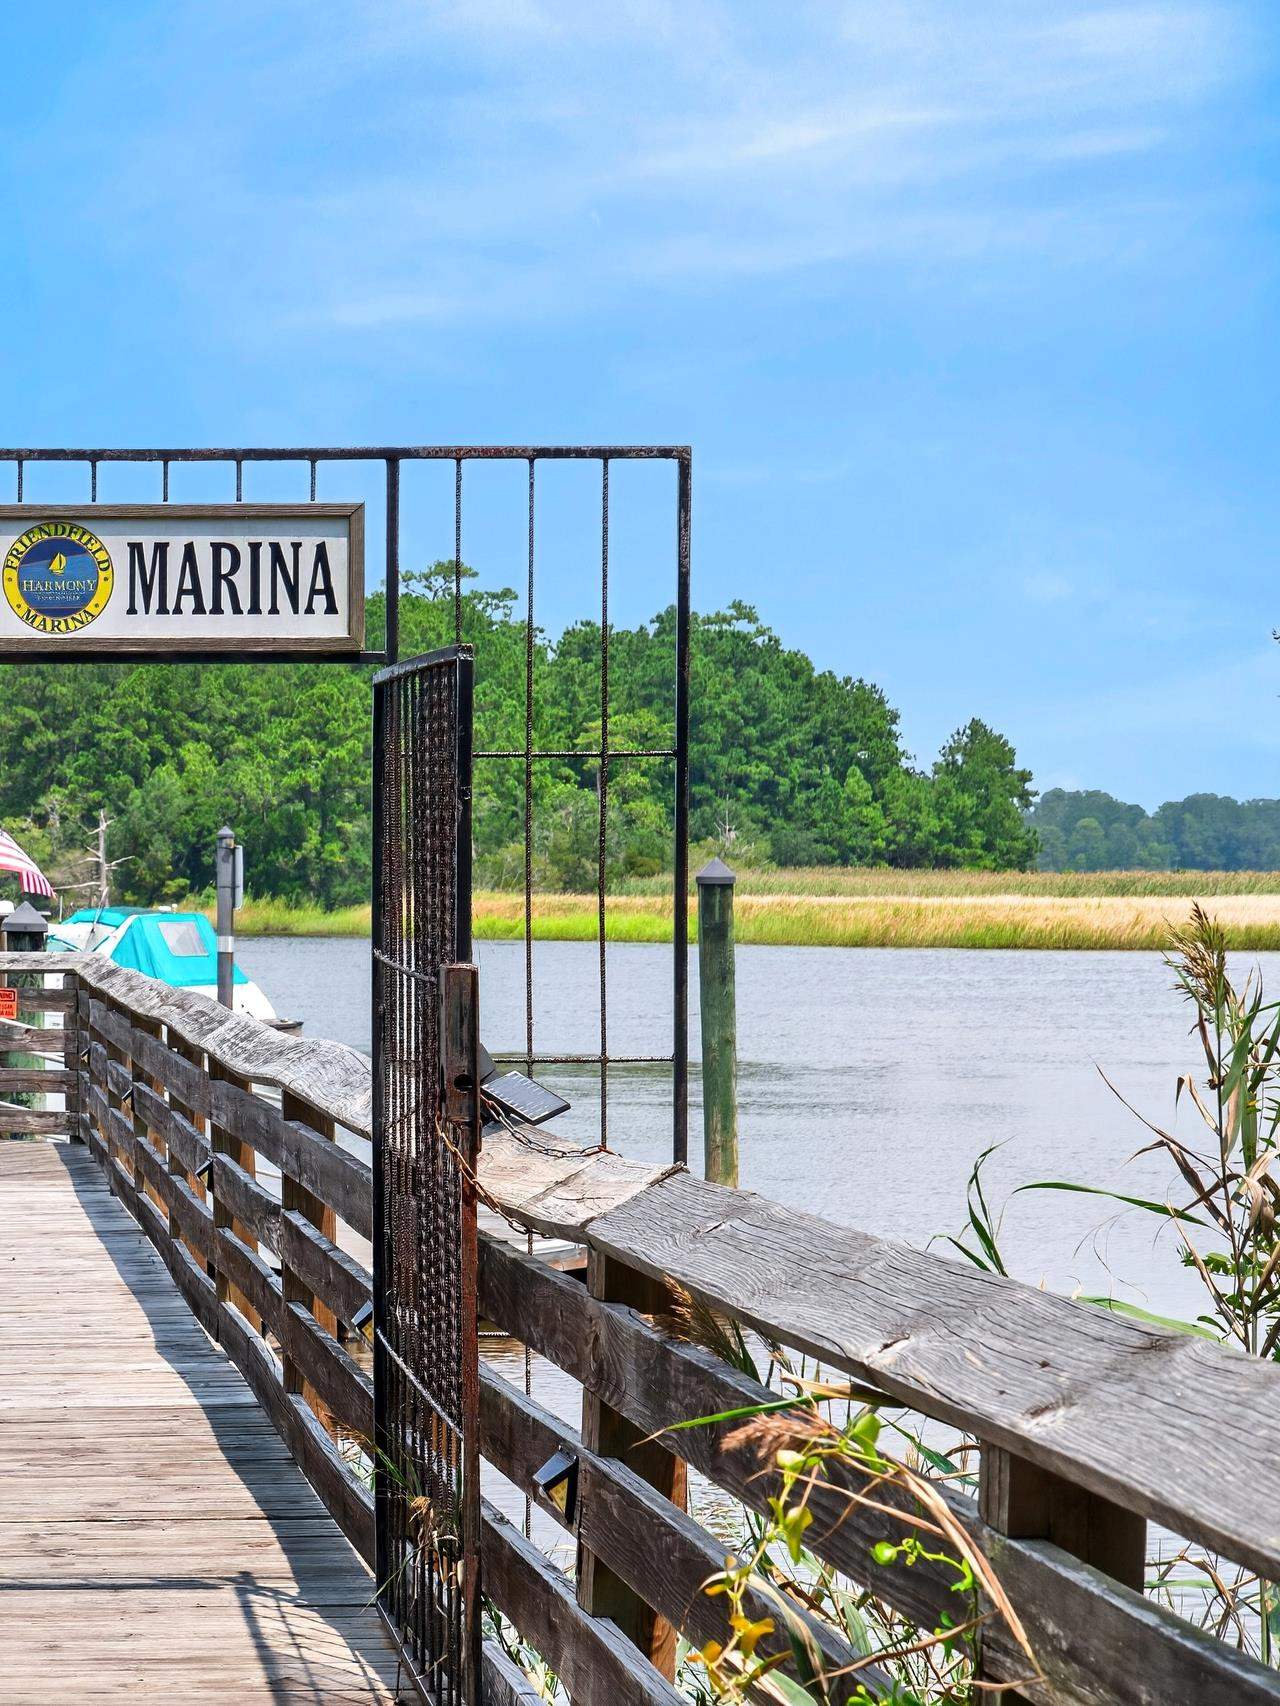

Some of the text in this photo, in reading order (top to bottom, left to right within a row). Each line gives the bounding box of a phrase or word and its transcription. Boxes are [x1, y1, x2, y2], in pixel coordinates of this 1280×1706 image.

[5, 523, 111, 571] FRIENDFIELD
[22, 579, 96, 592] HARMONY
[126, 541, 339, 615] MARINA
[22, 609, 96, 632] MARINA
